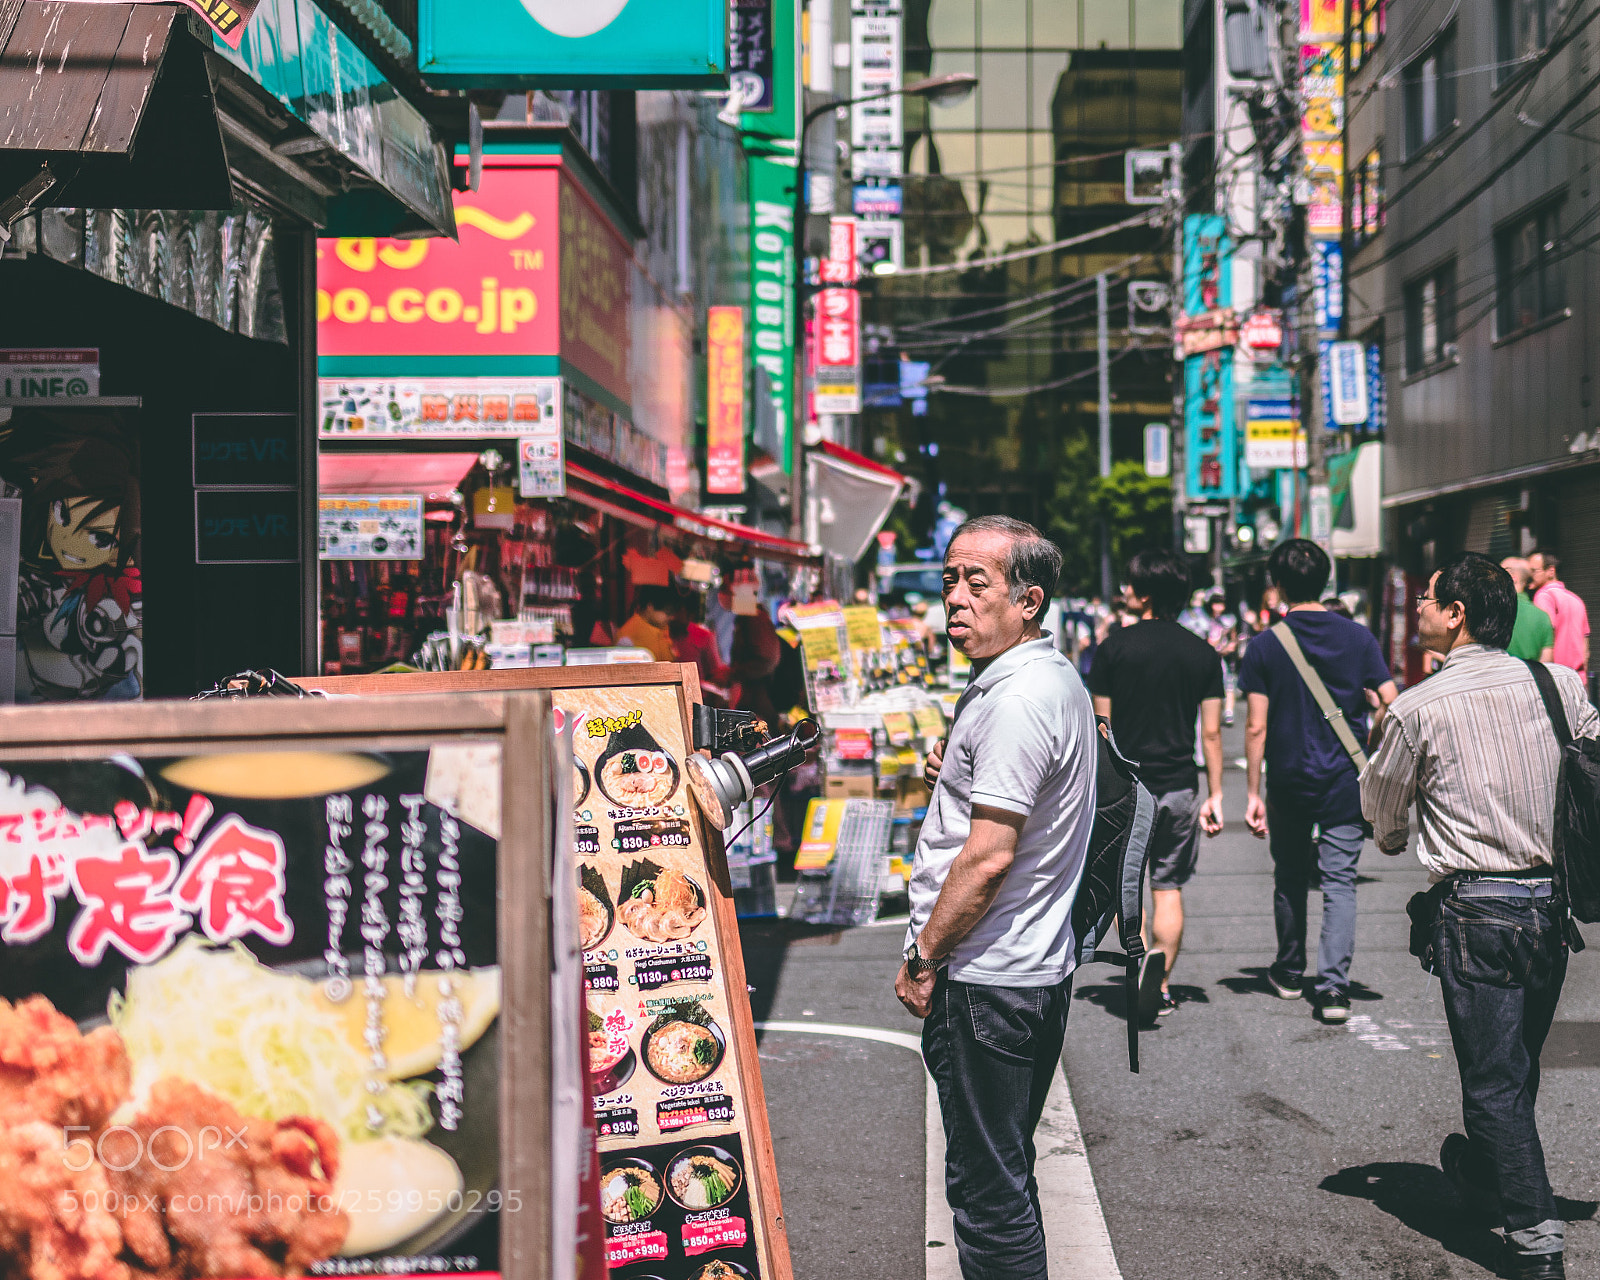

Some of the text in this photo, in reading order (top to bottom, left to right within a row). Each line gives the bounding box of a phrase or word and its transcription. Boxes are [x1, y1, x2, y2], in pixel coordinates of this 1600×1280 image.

[420, 394, 540, 422] 防災用品
[607, 807, 660, 820] 味玉ラーメン
[622, 836, 650, 849] 830円
[662, 833, 689, 846] 930円
[593, 976, 619, 988] 980円
[637, 970, 668, 983] 1130円
[681, 966, 713, 979] 1230円
[660, 1081, 724, 1098] ベジタブル家系
[708, 1107, 735, 1119] 630円
[612, 1120, 639, 1133] 930円
[690, 1235, 714, 1247] 850円
[722, 1229, 747, 1241] 950円
[610, 1249, 634, 1261] 830円
[641, 1244, 665, 1256] 930円
